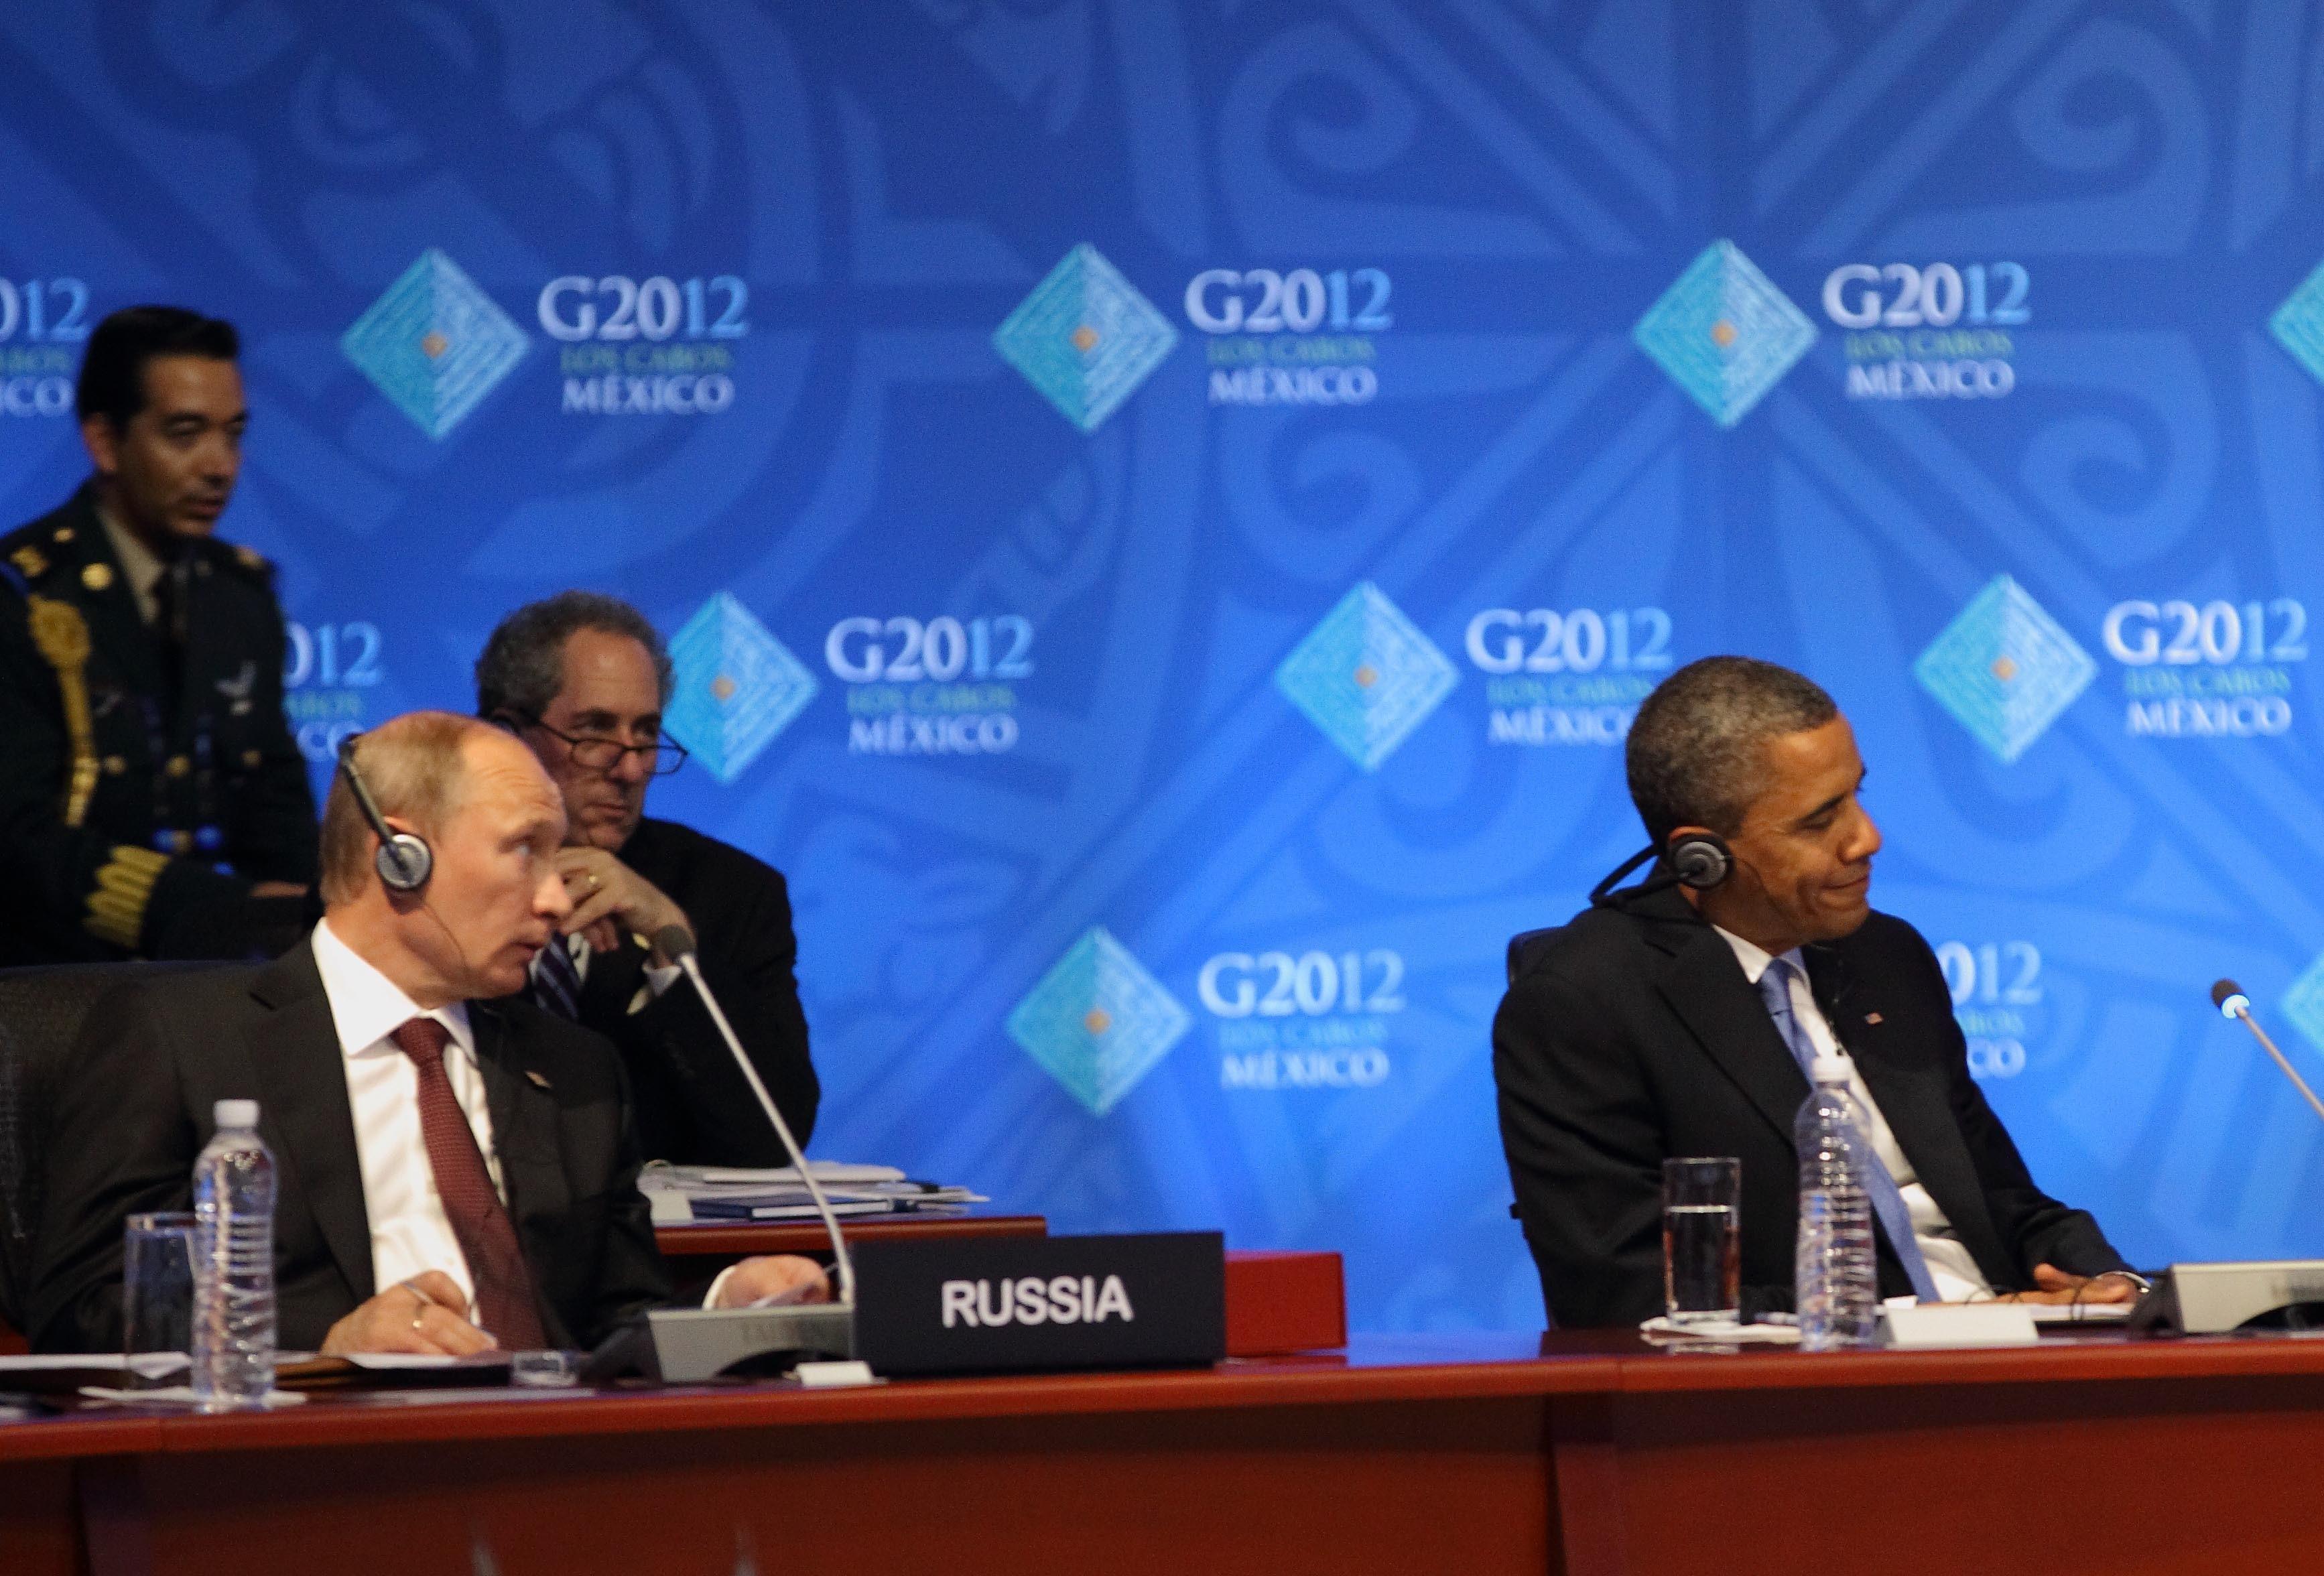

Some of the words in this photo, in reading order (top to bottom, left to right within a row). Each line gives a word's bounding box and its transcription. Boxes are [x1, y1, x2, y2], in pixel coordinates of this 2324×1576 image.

[537, 274, 749, 340] G2012
[1183, 267, 1393, 333] G2012
[1821, 261, 2032, 328] G2012
[562, 371, 735, 414] MÉXICO
[1208, 363, 1377, 404] MÉXICO
[1847, 356, 2014, 401] MÉXICO
[824, 614, 1036, 682] G2012
[1465, 607, 1673, 673] G2012
[2102, 598, 2309, 666] G2012
[848, 710, 1019, 754] MÉXICO
[2126, 693, 2292, 736] MÉXICO
[1198, 948, 1407, 1017] G2012
[1220, 1047, 1389, 1090] MÉXICO
[941, 1274, 1135, 1329] RUSSIA
